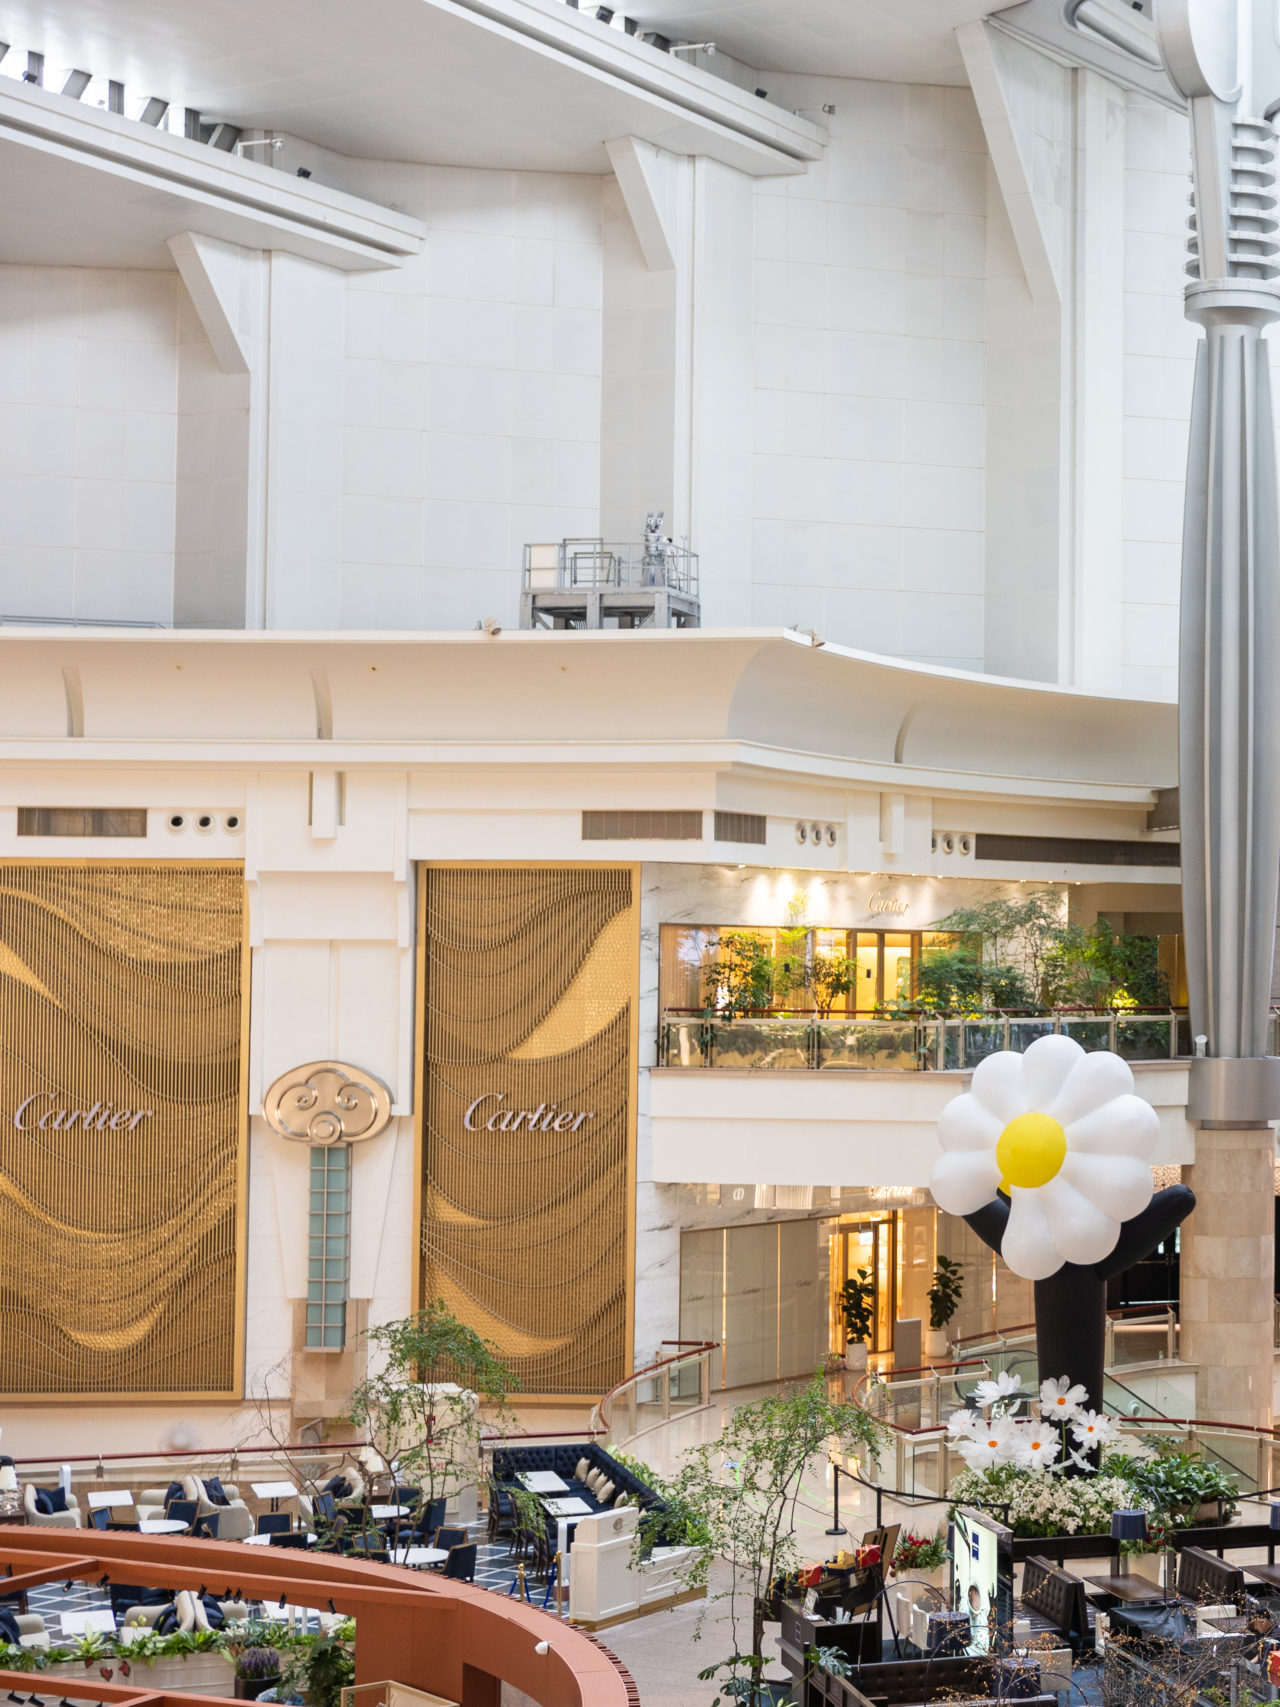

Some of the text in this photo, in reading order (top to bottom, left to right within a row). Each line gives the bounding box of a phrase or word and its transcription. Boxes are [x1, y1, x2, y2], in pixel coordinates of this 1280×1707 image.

[867, 890, 910, 913] Cartier
[14, 1090, 154, 1130] Cartier
[463, 1092, 595, 1132] Cartier
